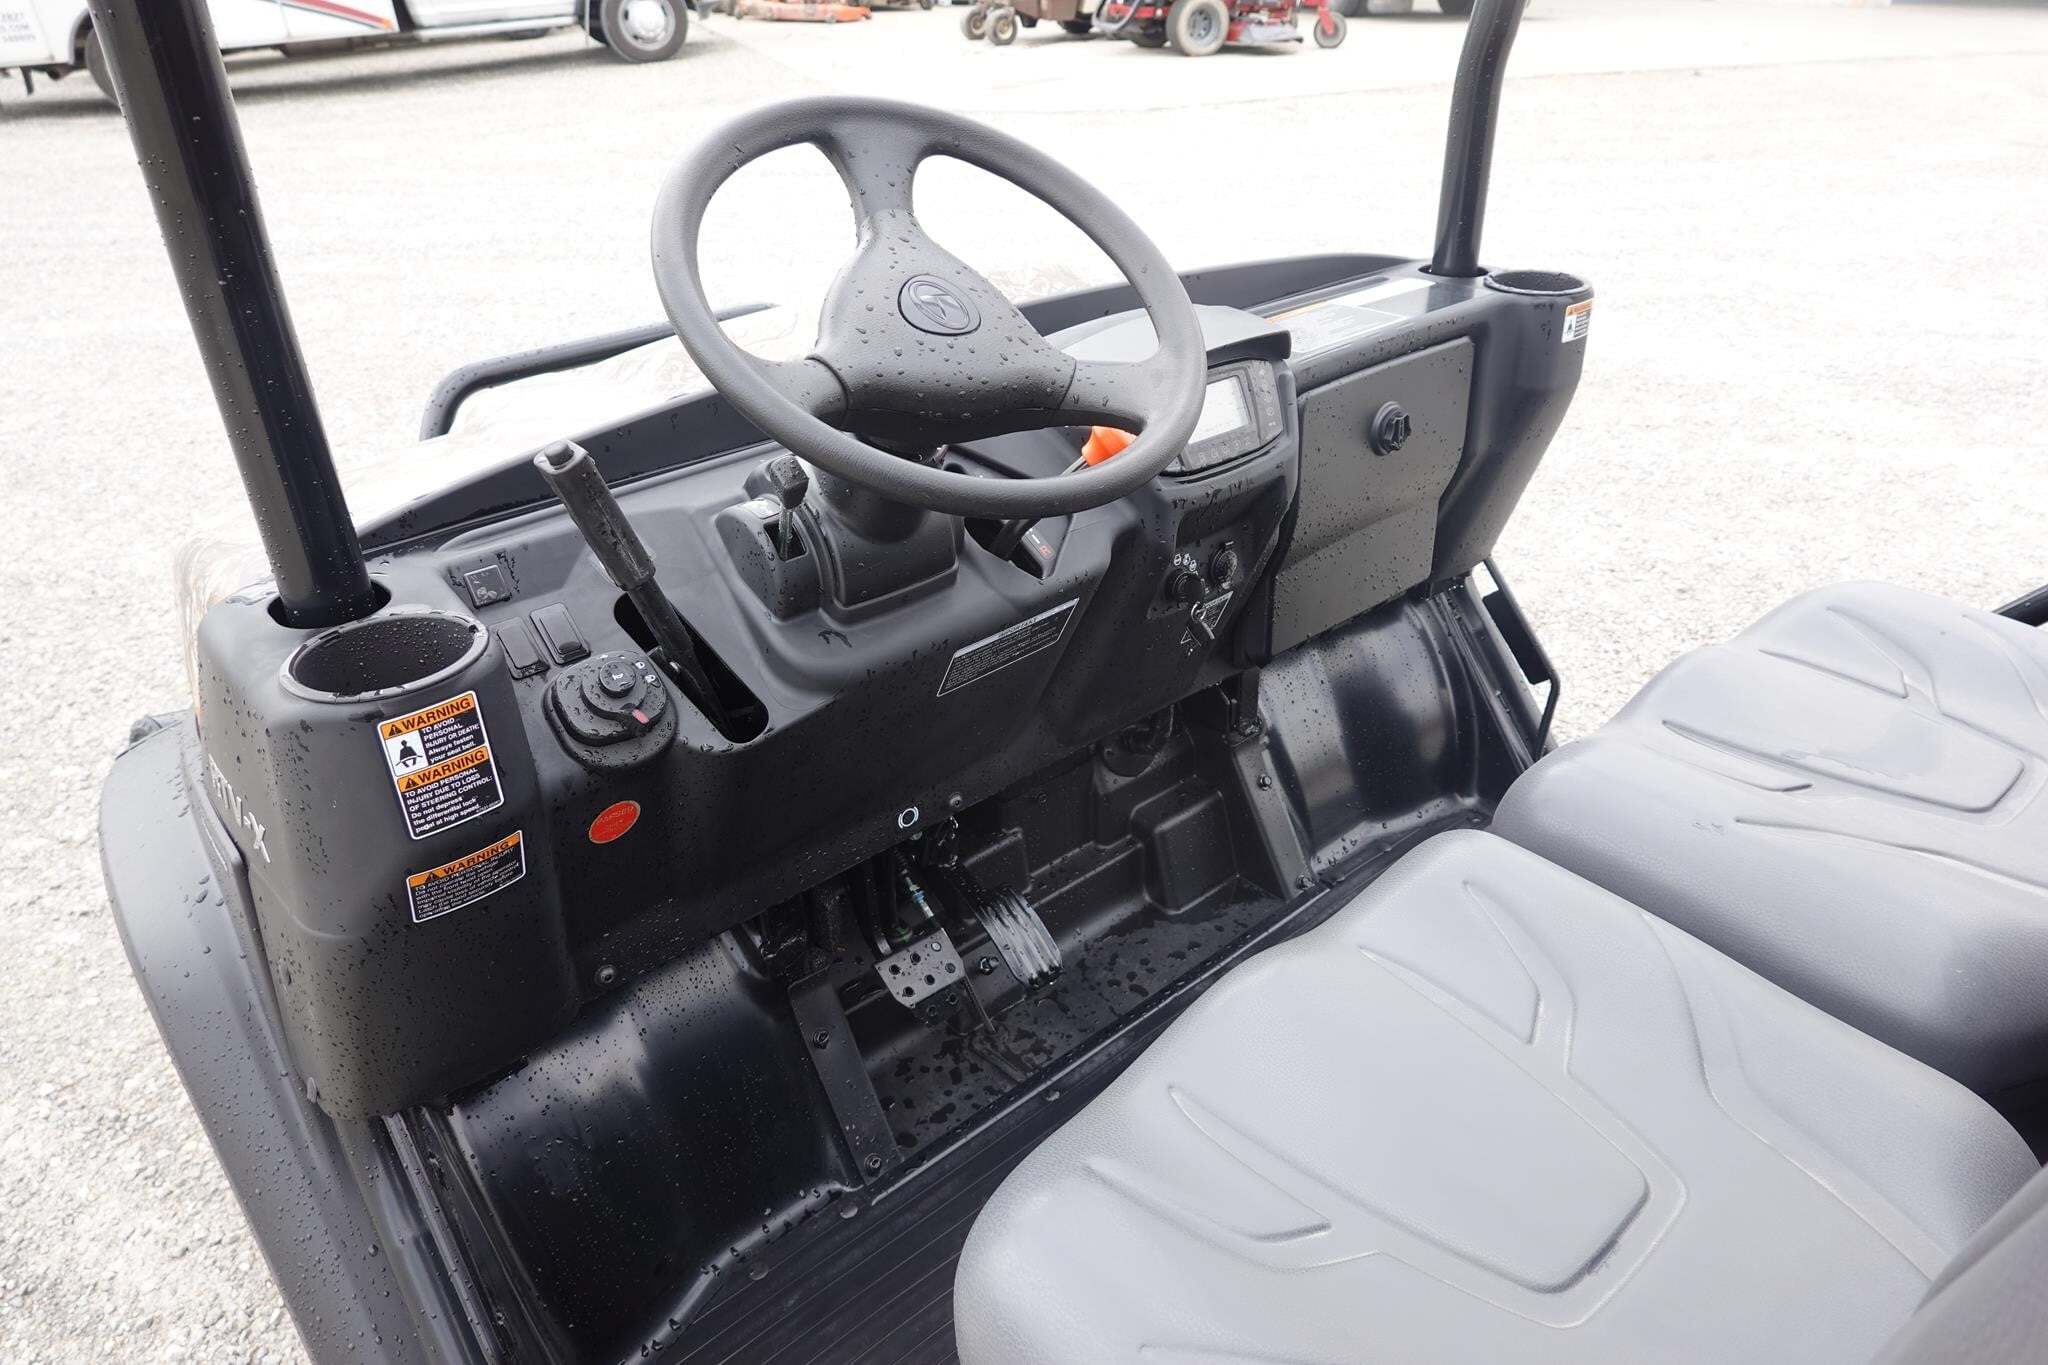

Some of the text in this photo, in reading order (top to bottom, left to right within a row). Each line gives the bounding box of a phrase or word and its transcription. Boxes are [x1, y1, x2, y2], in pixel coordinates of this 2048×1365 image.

[402, 697, 470, 731] WARNING
[421, 717, 454, 734] TO AVOID
[423, 722, 462, 741] PERSONAL
[425, 736, 447, 749] INJURY
[447, 732, 457, 740] OR
[428, 733, 473, 756] Always fasten
[418, 750, 484, 784] WARNING
[430, 752, 446, 763] your
[446, 746, 461, 756] seat
[404, 766, 477, 799] TO AVOID PERSONAL
[406, 772, 480, 806] INJURY DUE TO LOSS
[409, 803, 420, 812] OF
[421, 789, 456, 808] STEERING
[457, 774, 492, 793] CONTROL:
[411, 795, 462, 819] Do not depress
[413, 796, 476, 826] the differential lock
[415, 821, 434, 834] pedal
[443, 811, 459, 823] high
[459, 802, 481, 816] speed.
[443, 842, 508, 874] WARNING
